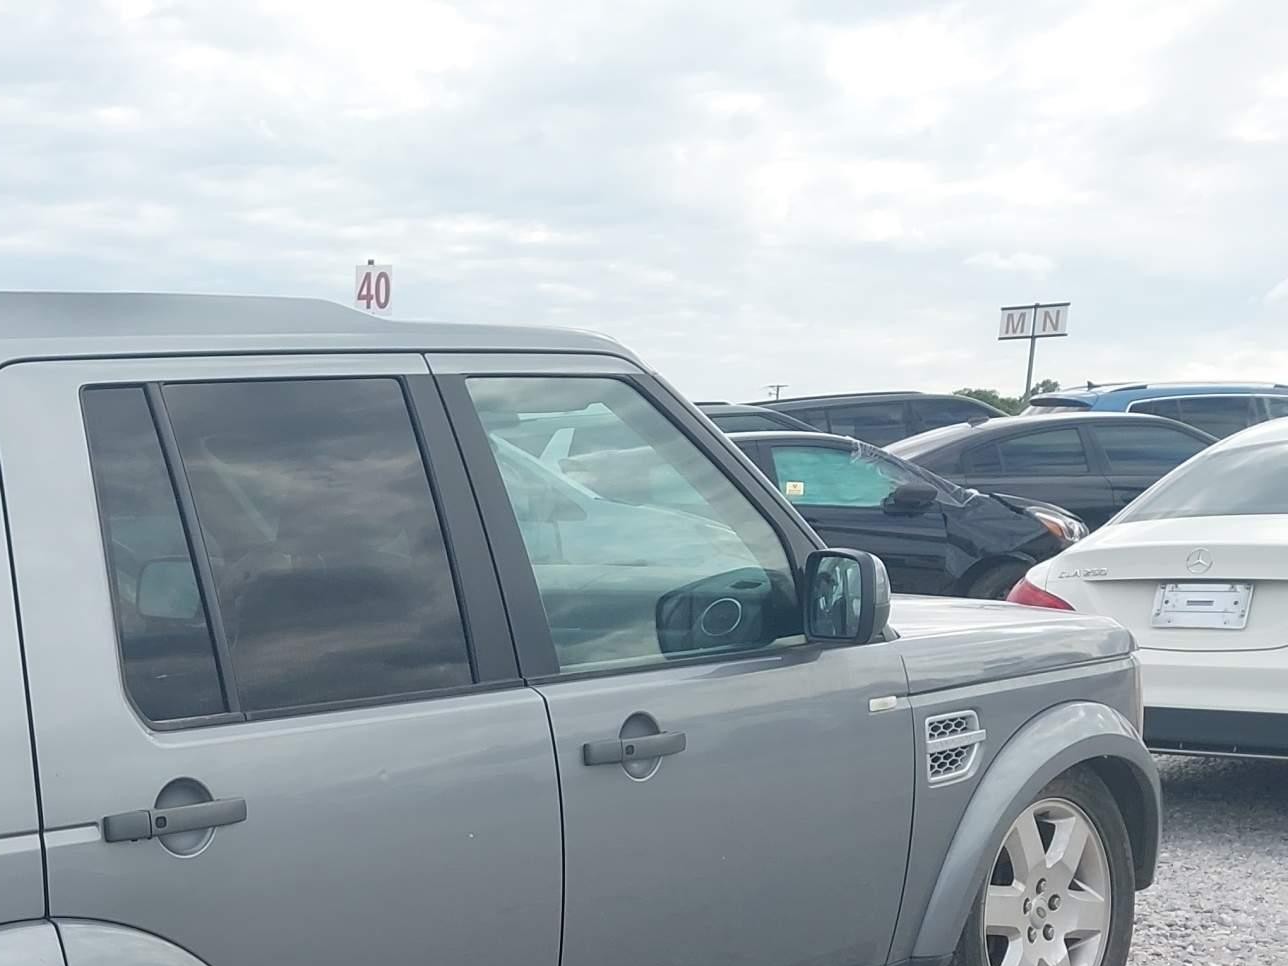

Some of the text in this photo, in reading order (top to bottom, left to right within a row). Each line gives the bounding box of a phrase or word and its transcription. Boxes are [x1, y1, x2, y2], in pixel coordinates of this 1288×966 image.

[357, 271, 391, 310] 40
[1004, 309, 1061, 335] M N
